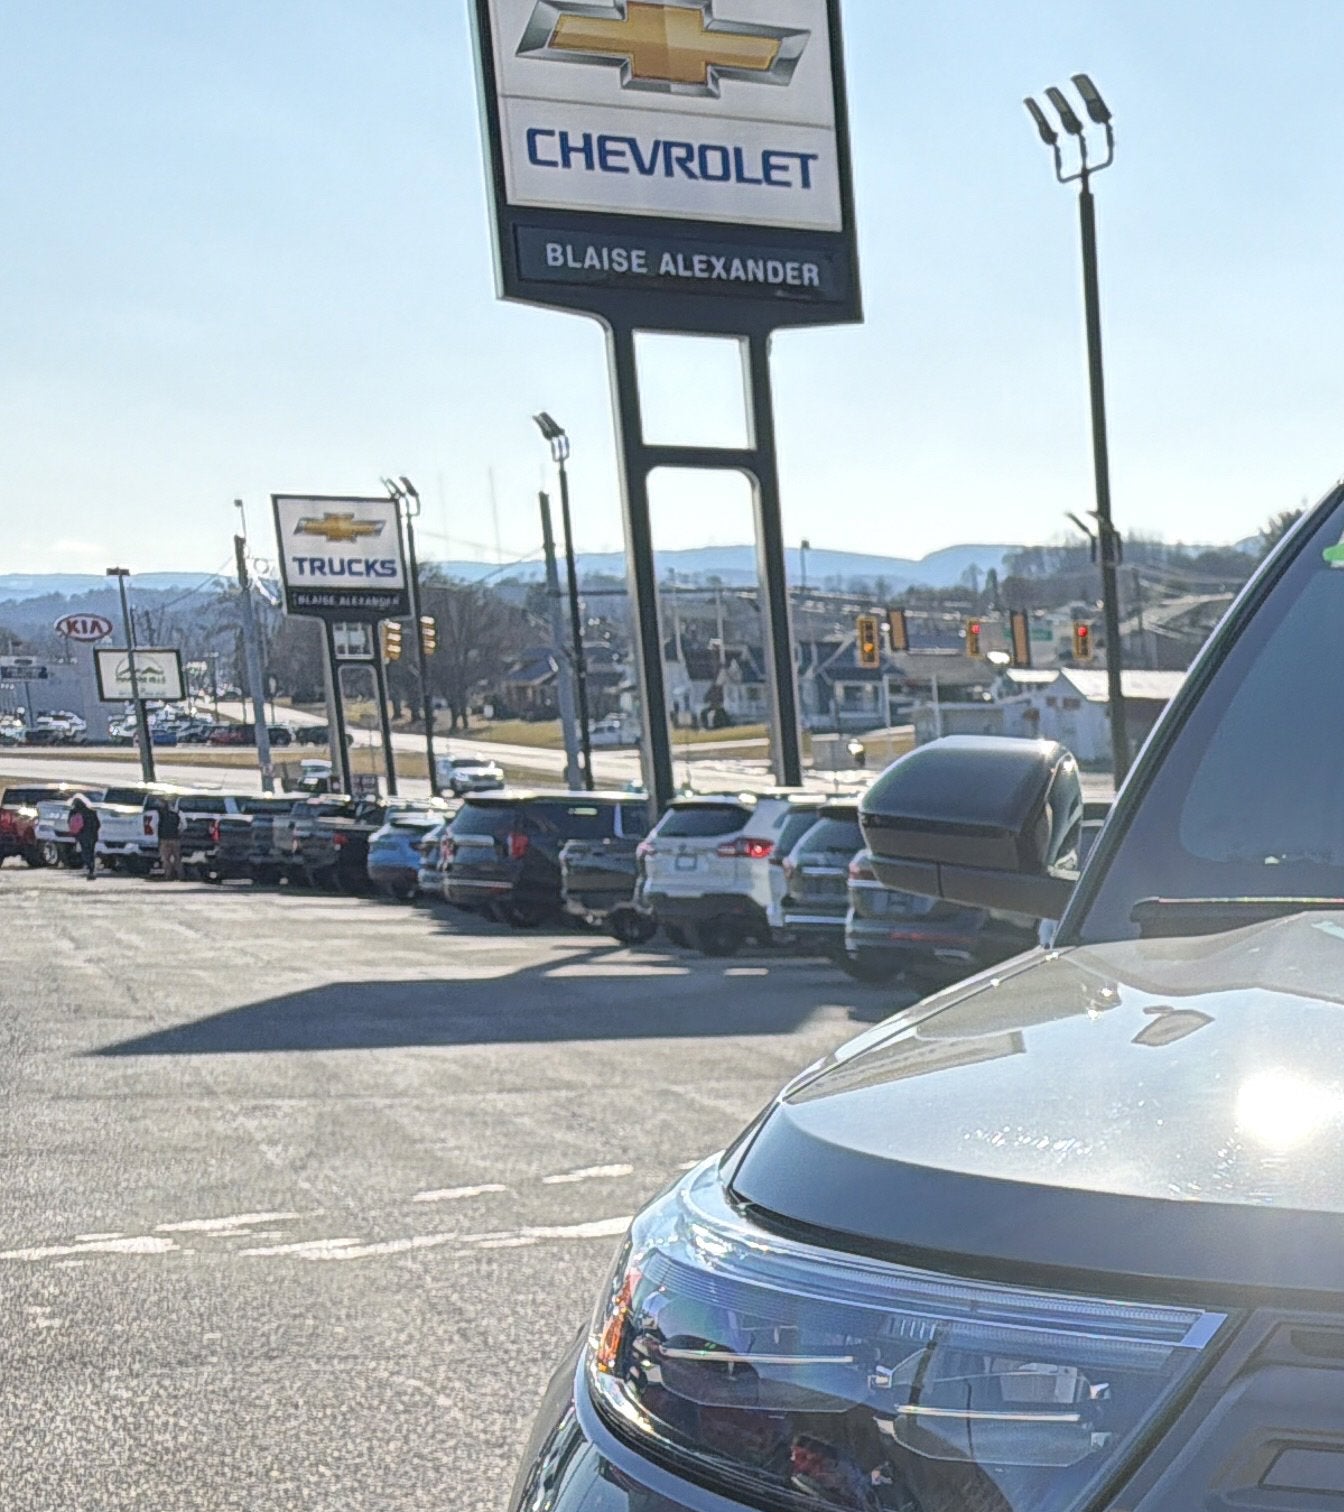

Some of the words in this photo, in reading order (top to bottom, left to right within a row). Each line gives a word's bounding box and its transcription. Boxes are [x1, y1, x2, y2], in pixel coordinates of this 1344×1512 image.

[526, 127, 819, 190] CHEVROLET
[545, 242, 648, 274] BLAISE
[659, 252, 820, 288] ALEXANDER
[292, 556, 398, 578] TRUCKS
[66, 619, 104, 635] KIA
